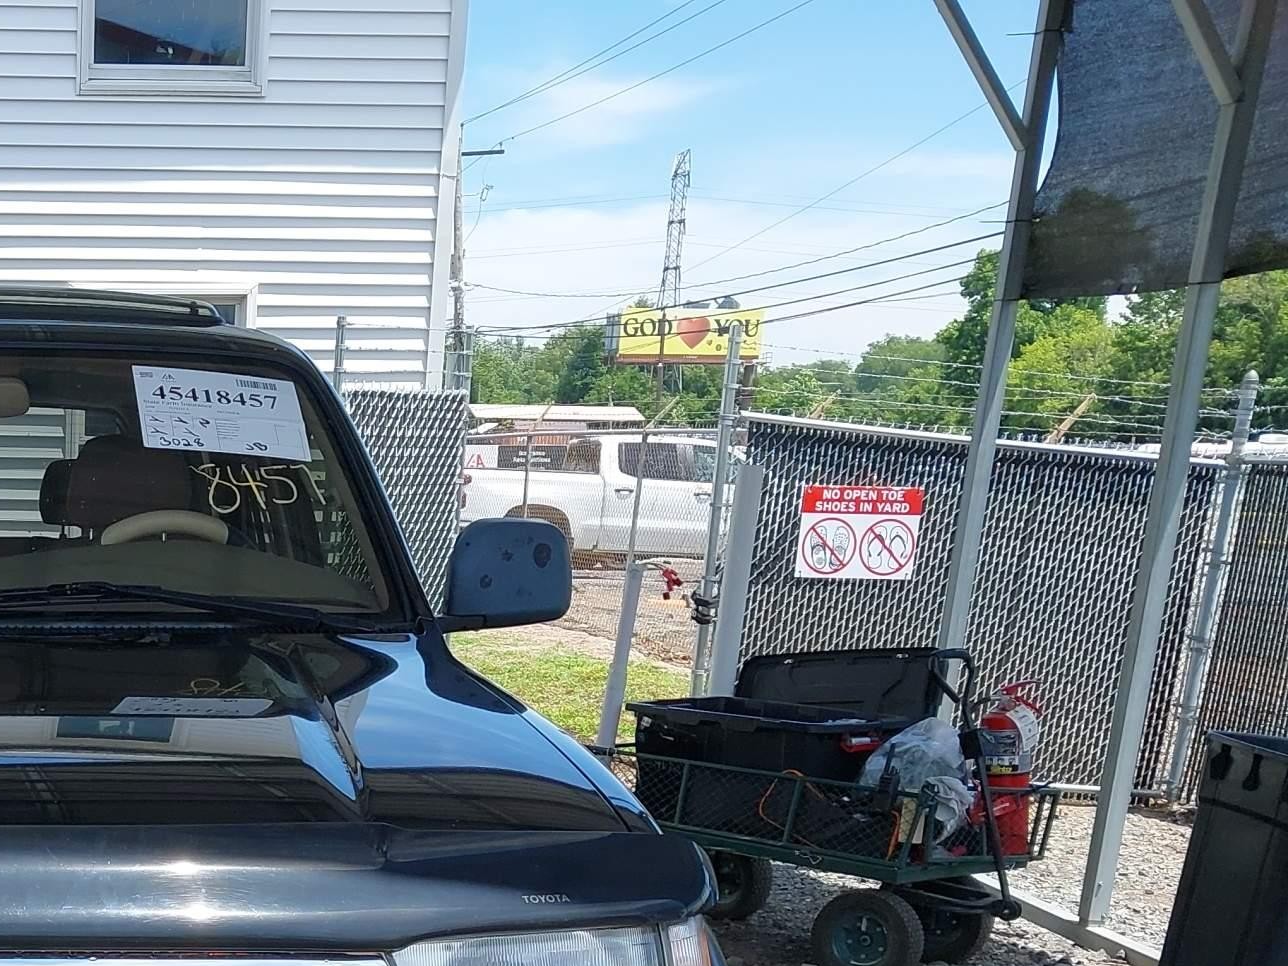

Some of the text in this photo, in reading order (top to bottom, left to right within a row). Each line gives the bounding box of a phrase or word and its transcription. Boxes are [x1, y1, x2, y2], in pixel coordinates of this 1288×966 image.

[623, 318, 672, 337] GOD
[152, 384, 278, 410] 45418457
[159, 436, 205, 447] 3028
[190, 463, 327, 514] 8457
[823, 489, 905, 500] NO OPEN TOE
[815, 501, 910, 513] SHOES IN YARD
[521, 894, 571, 904] TOYOTA
